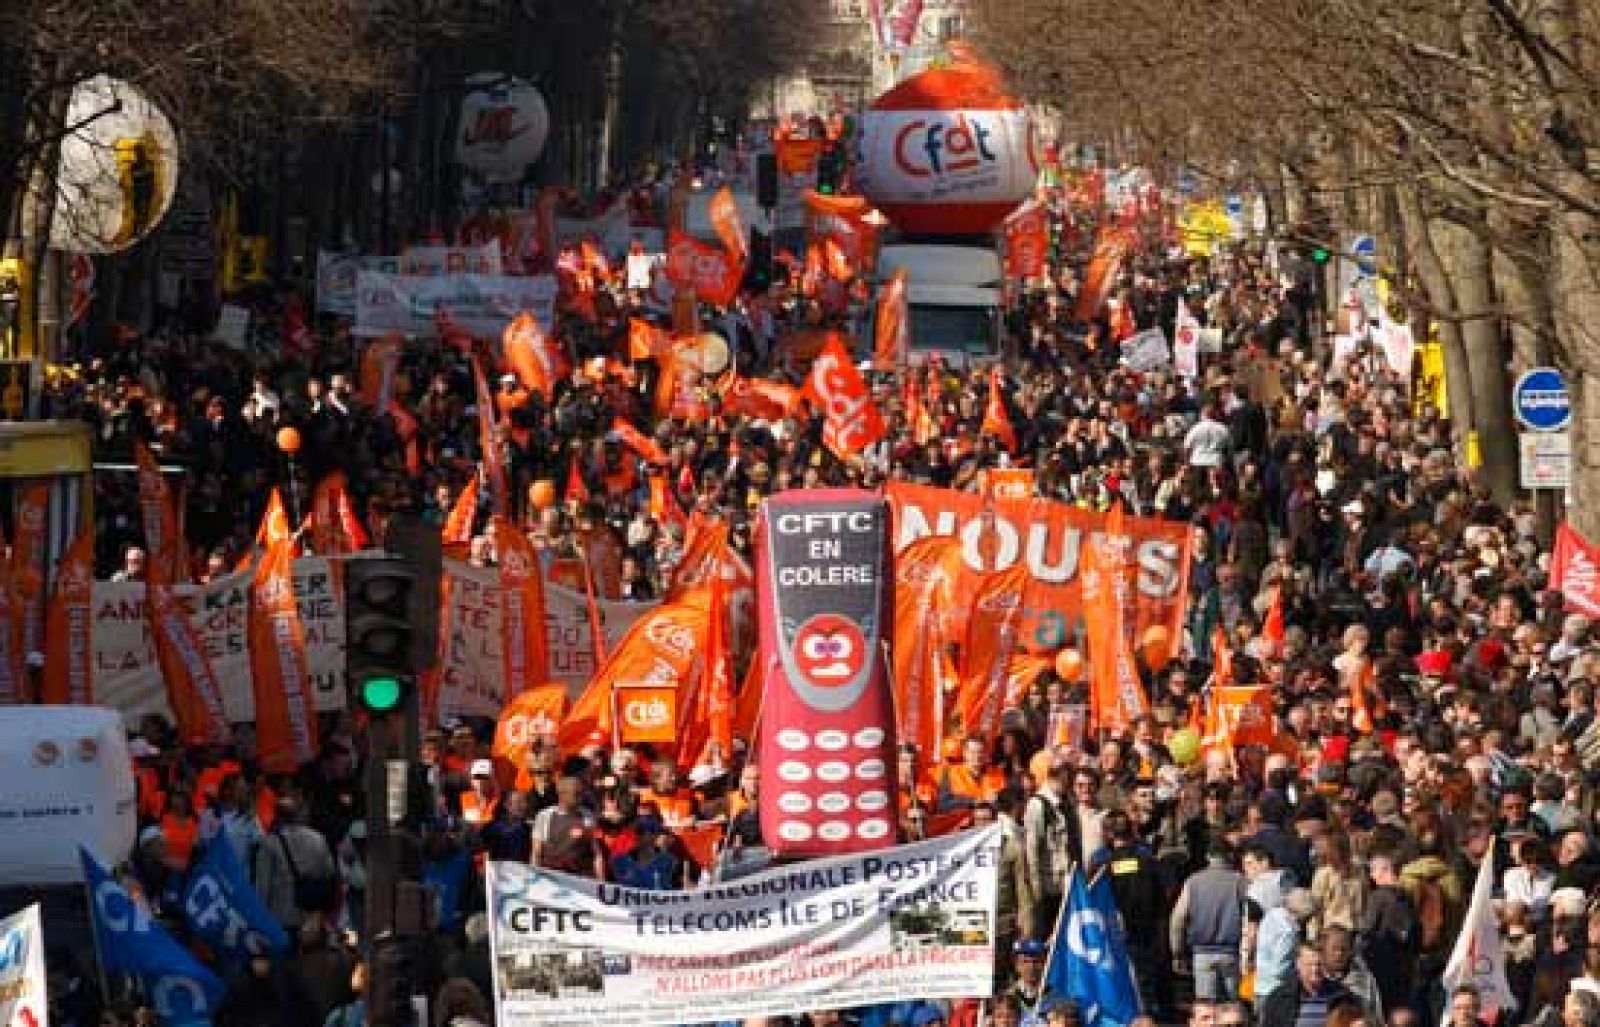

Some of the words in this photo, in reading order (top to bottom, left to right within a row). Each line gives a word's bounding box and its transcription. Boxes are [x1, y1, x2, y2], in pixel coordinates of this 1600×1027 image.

[777, 511, 873, 534] CFTC
[808, 538, 841, 559] EN
[511, 906, 593, 933] CFTC
[831, 899, 865, 920] DE
